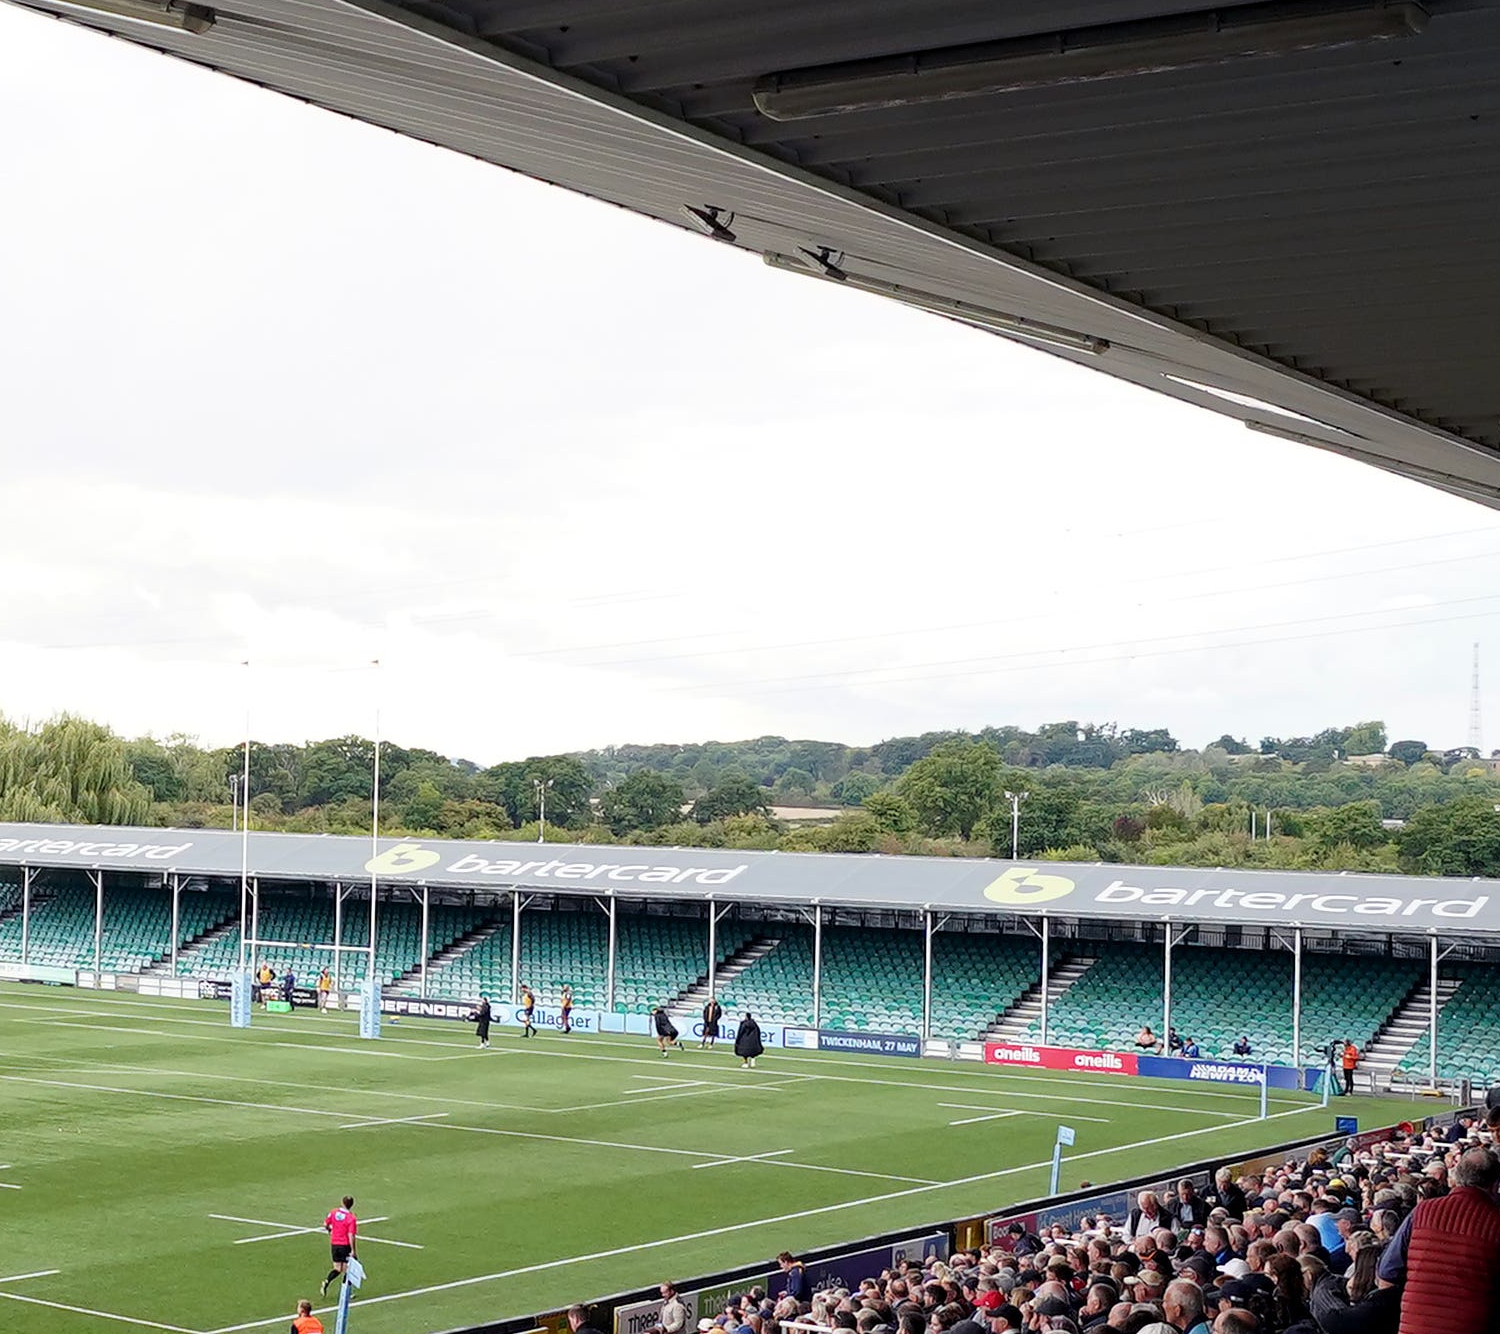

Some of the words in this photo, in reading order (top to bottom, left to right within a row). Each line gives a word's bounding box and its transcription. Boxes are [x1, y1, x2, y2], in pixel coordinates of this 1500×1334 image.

[446, 854, 748, 885] bartercard
[1095, 881, 1489, 918] bartercard
[820, 1035, 883, 1051] TWICKENHAM,
[884, 1041, 896, 1051] 27
[897, 1041, 918, 1053] MAY
